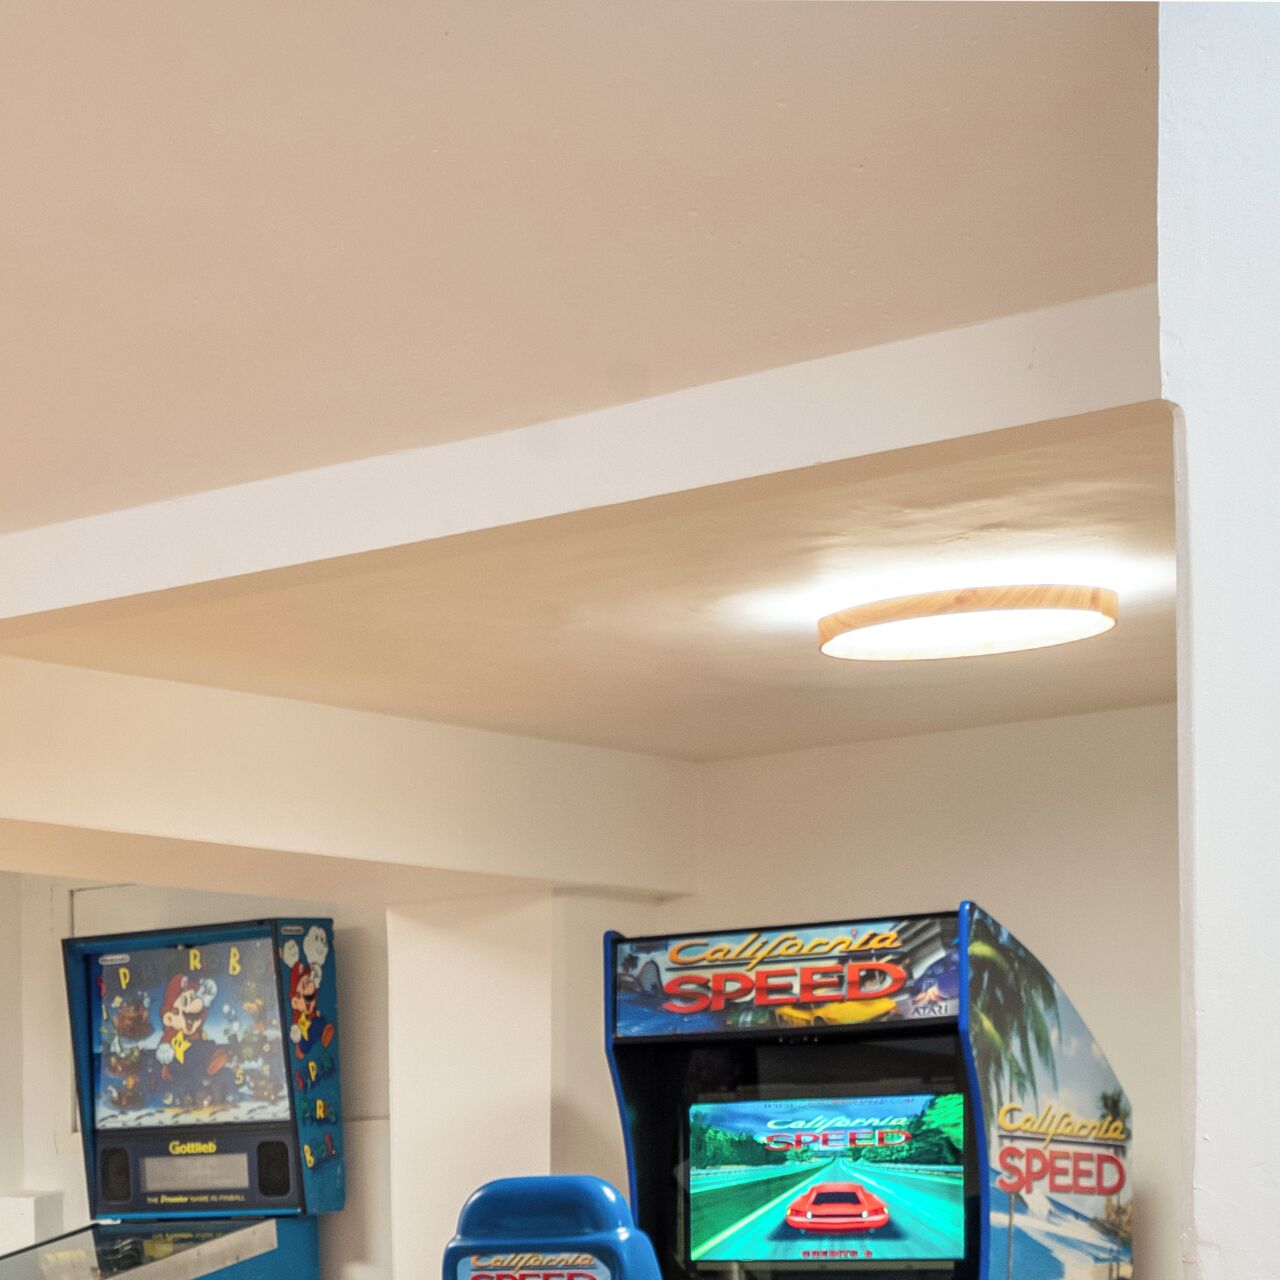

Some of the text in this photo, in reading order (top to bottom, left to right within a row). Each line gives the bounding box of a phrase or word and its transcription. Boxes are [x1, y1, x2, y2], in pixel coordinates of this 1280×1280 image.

[668, 930, 903, 971] California
[662, 961, 907, 1014] SPEED
[912, 1004, 948, 1017] ATARI
[767, 1115, 908, 1132] California
[998, 1103, 1127, 1149] California
[168, 1140, 217, 1155] Gottlieb
[765, 1129, 912, 1151] SPEED
[997, 1146, 1127, 1196] SPEED
[470, 1252, 596, 1273] California
